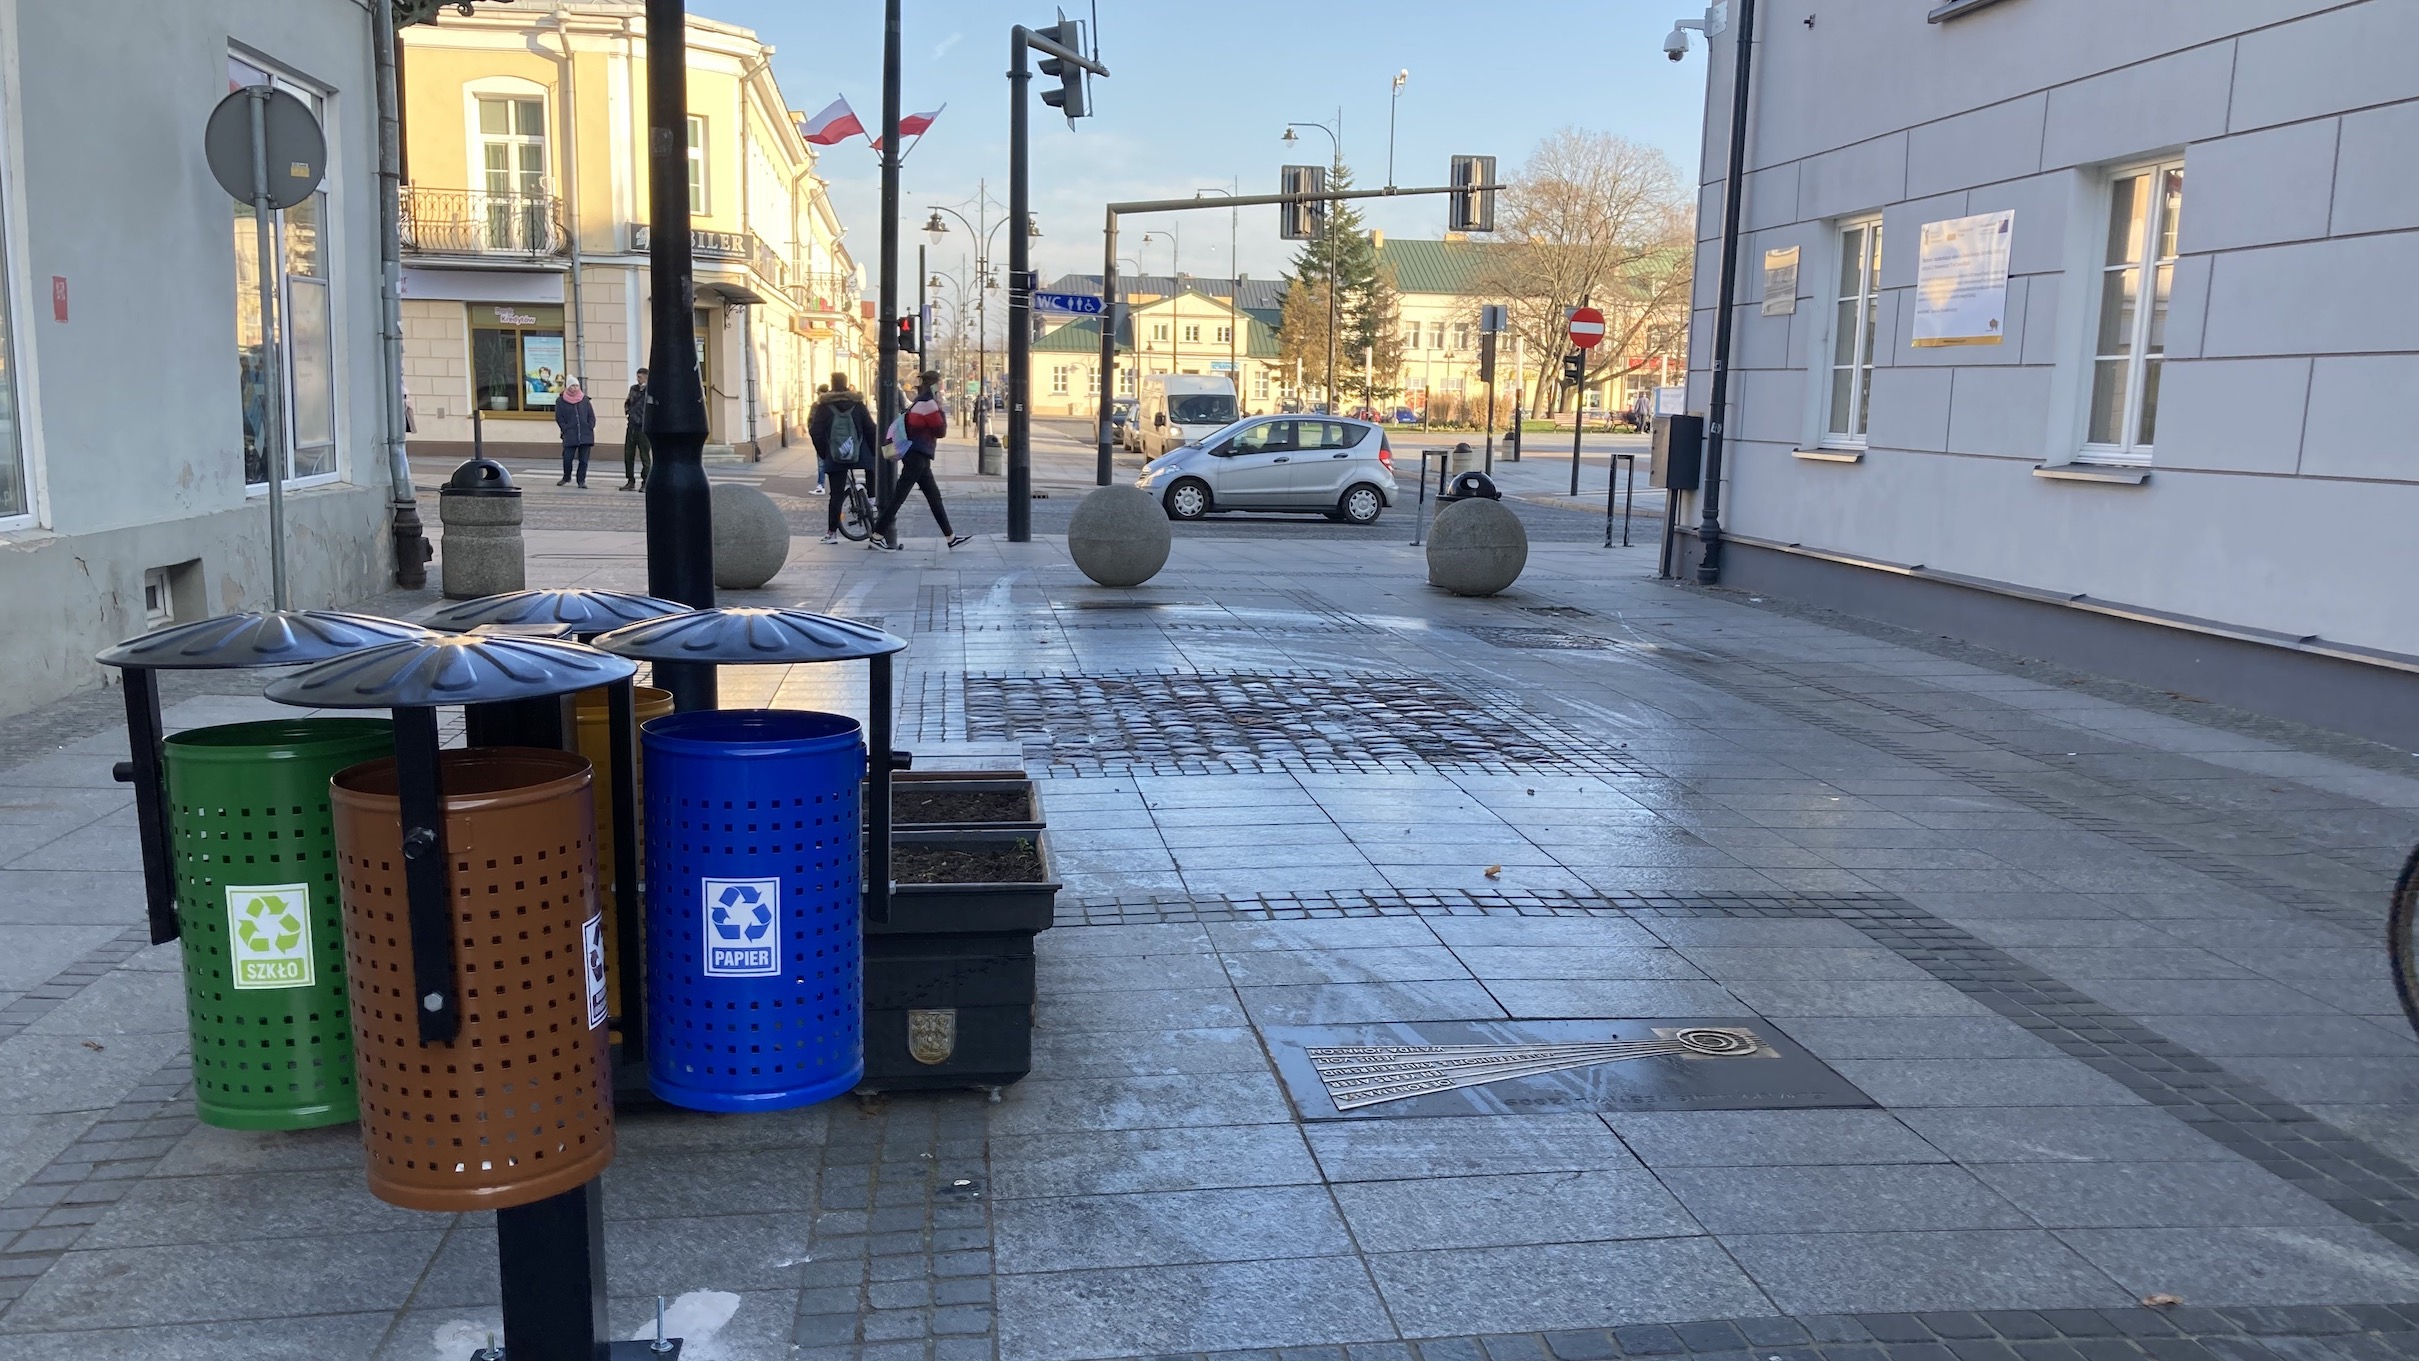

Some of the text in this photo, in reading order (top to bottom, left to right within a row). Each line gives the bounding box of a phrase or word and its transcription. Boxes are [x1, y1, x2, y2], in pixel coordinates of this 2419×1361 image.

[1036, 295, 1061, 309] WC
[495, 307, 514, 316] Bank
[501, 315, 536, 326] Kredytów
[715, 950, 769, 966] PAPIER
[246, 961, 298, 979] SZKŁO
[1316, 1055, 1396, 1065] JESUS VOLT
[1400, 1061, 1435, 1070] KNUT
[1329, 1070, 1447, 1088] TEN YEARS AFTER
[1336, 1079, 1457, 1101] JOE BONAMASSA
